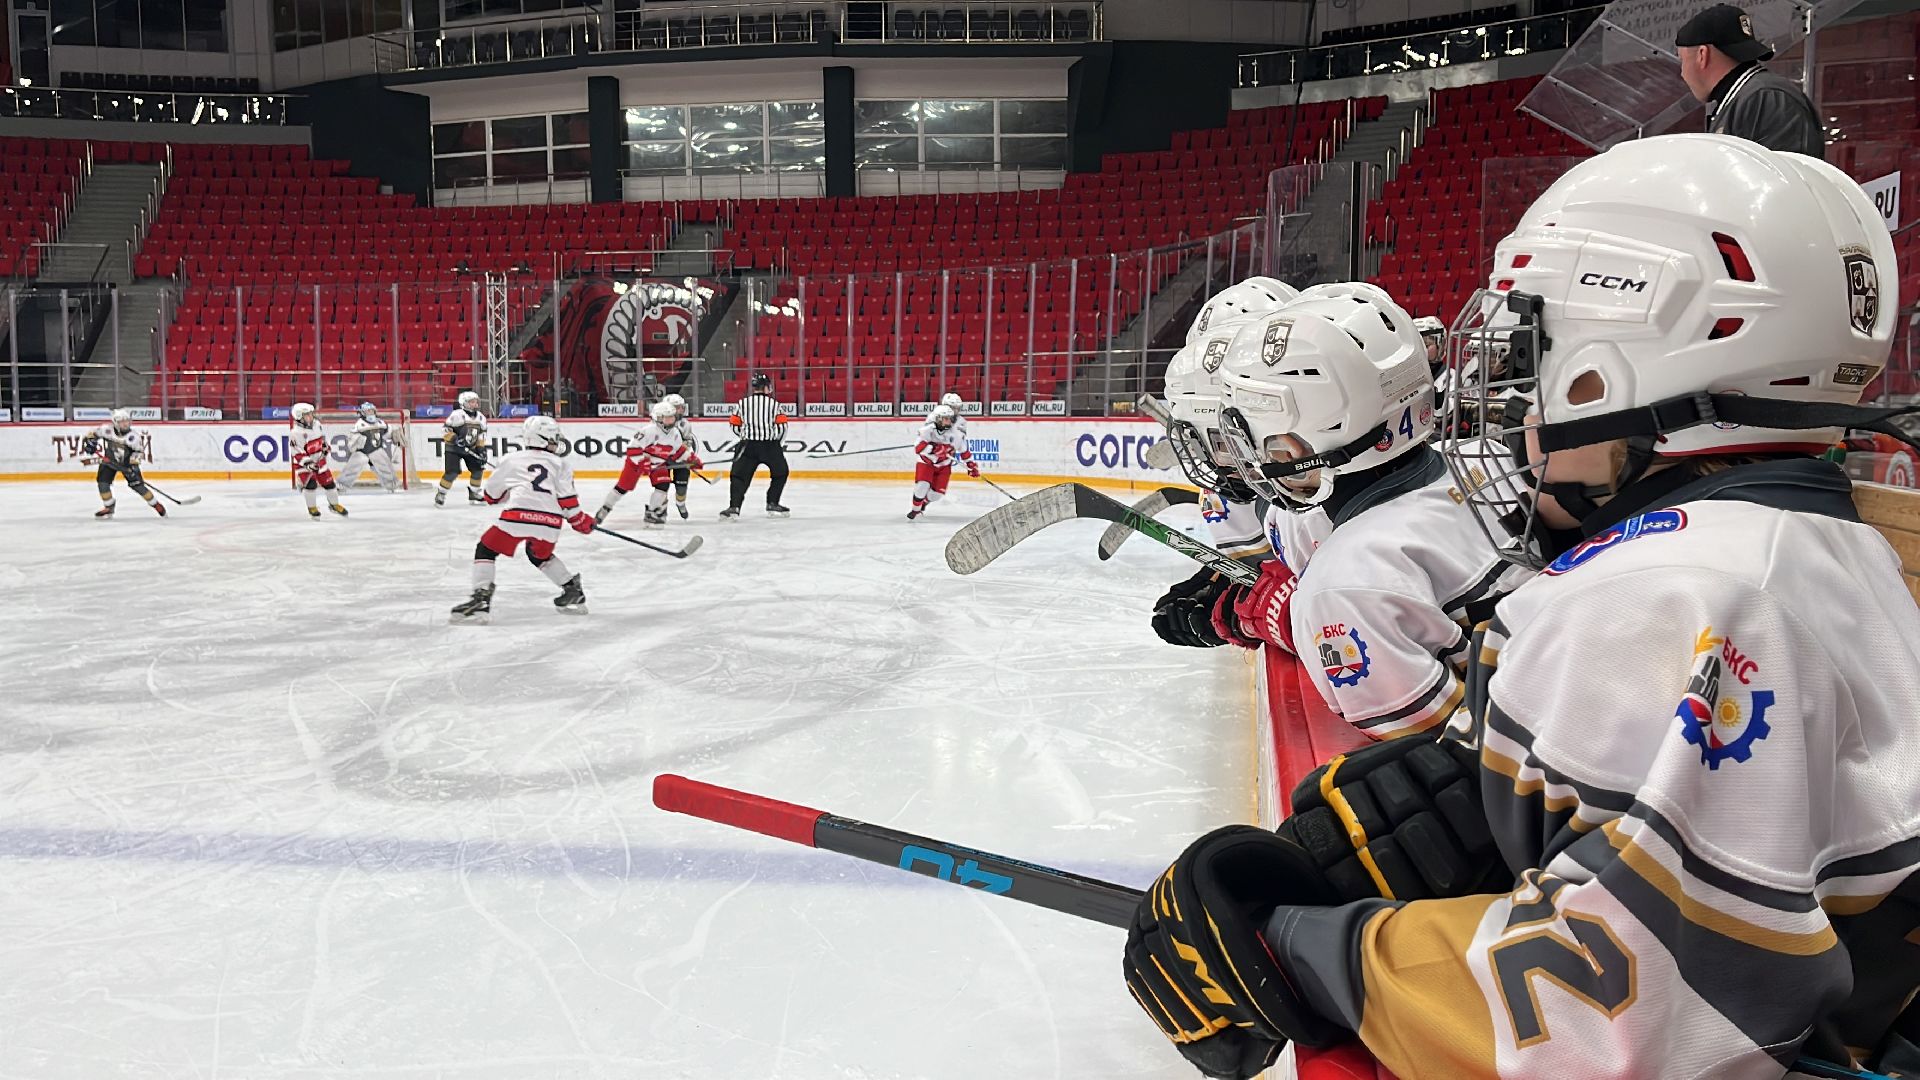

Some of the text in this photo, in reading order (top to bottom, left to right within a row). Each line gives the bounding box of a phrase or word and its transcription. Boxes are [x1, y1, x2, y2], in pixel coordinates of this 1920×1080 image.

[1579, 272, 1649, 294] CCM
[601, 405, 636, 414] KHL.RU
[706, 405, 737, 414] KHL.R
[808, 405, 842, 413] KHL.RU
[857, 404, 891, 413] KHL.RU
[993, 403, 1024, 412] KHL.RU
[1034, 403, 1063, 411] KHL.RU
[1398, 405, 1414, 440] 4
[527, 463, 552, 495] 2
[1322, 623, 1347, 639] БКС
[1721, 635, 1759, 685] БКС
